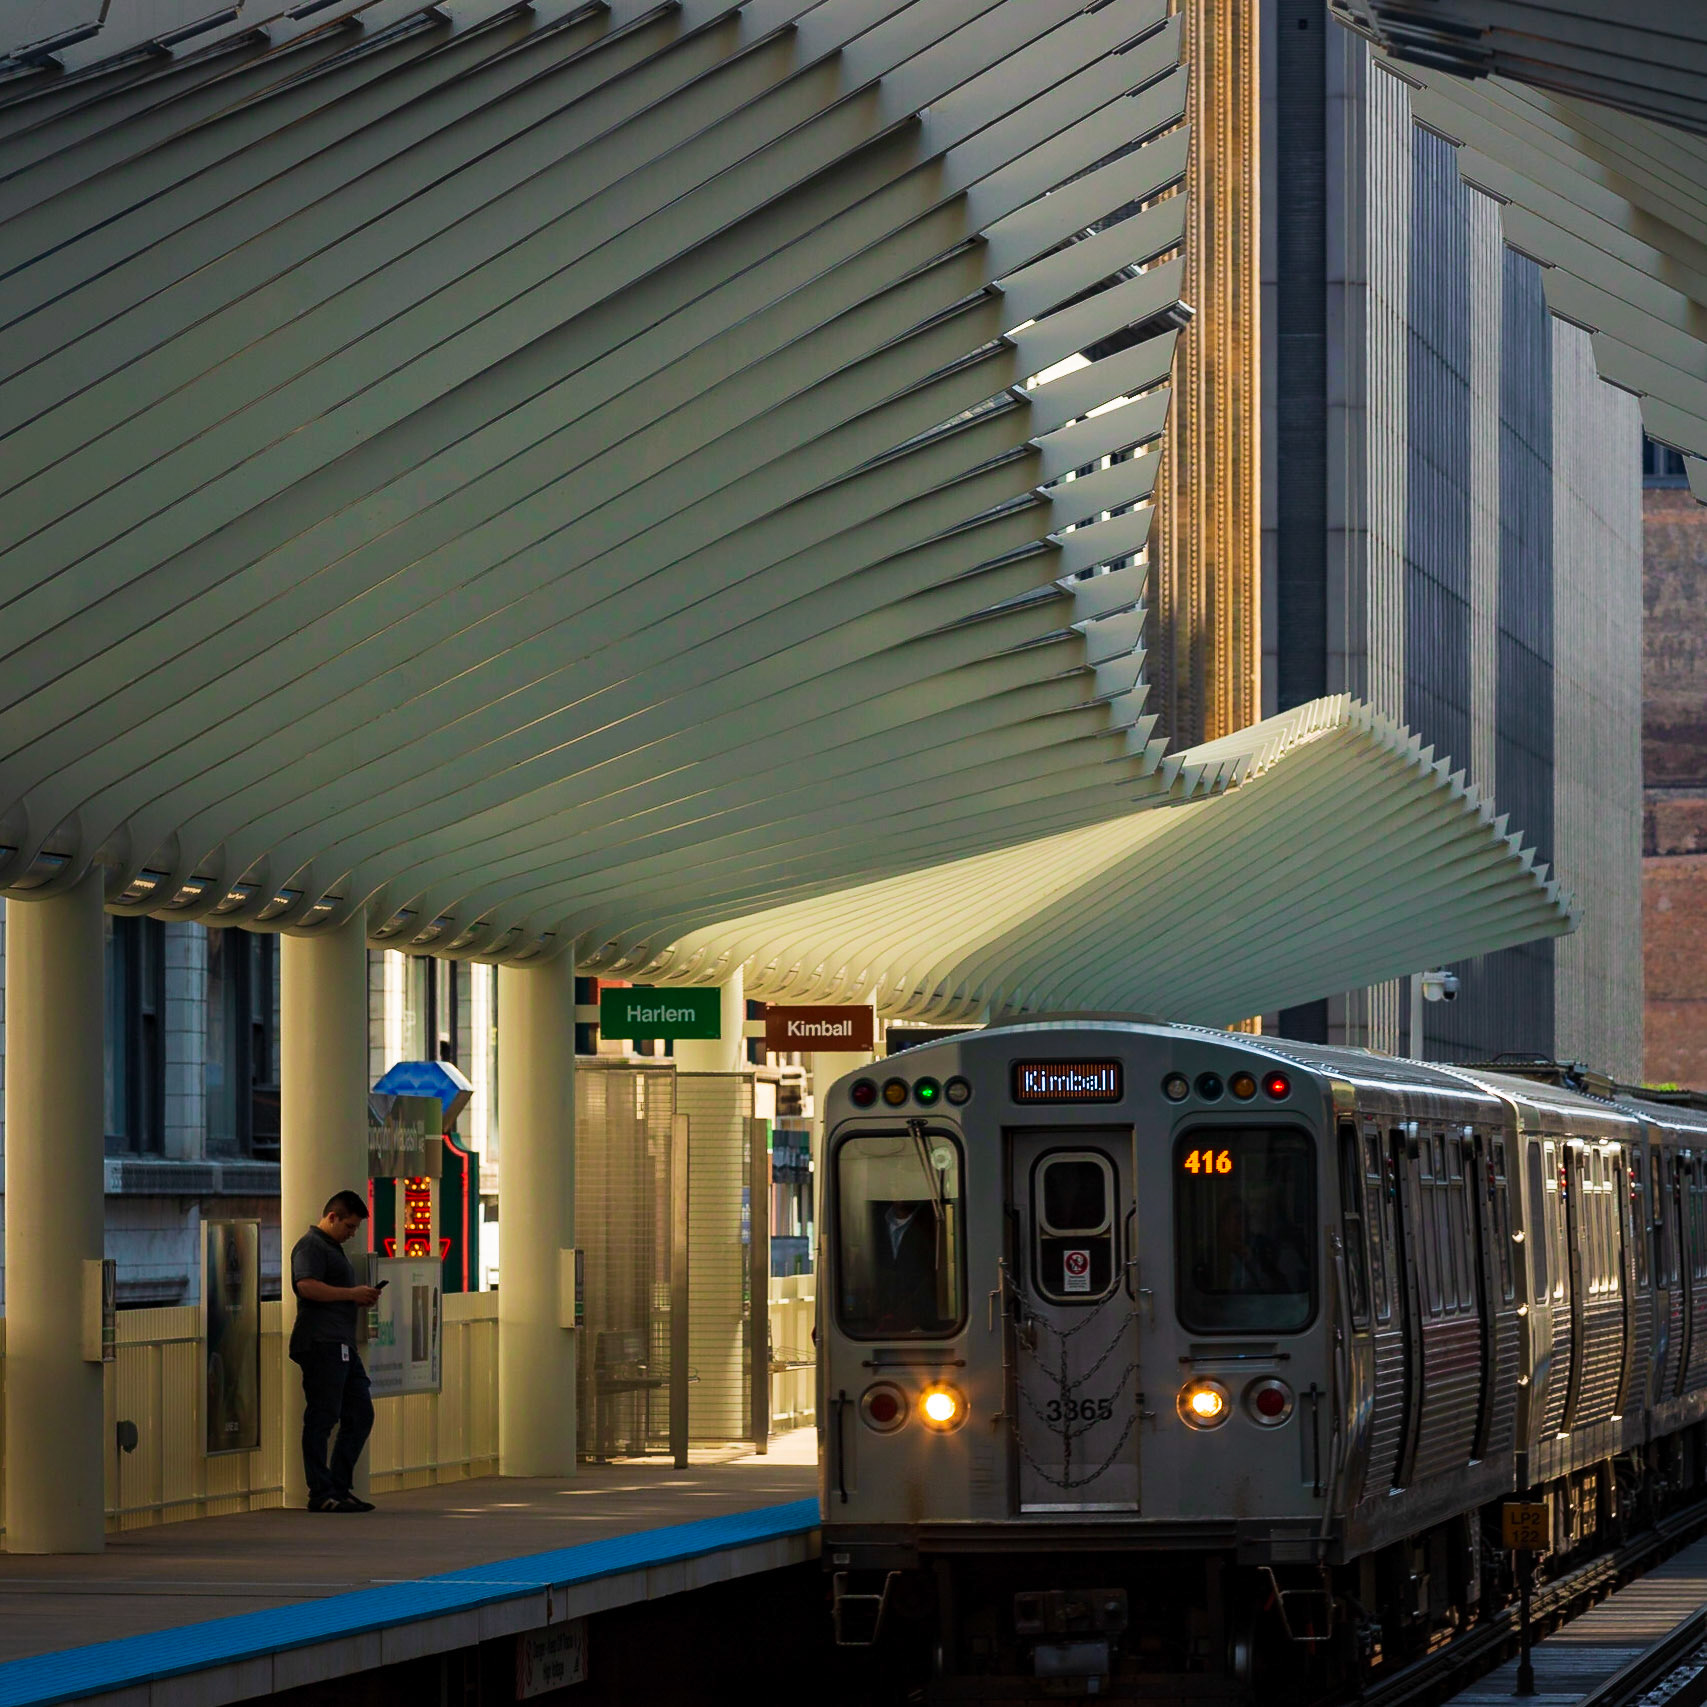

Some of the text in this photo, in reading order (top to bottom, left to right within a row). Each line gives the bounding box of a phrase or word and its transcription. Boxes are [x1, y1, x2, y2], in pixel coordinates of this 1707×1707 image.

[627, 1005, 695, 1022] Harlem
[788, 1020, 852, 1037] Kimball
[1025, 1069, 1114, 1092] Kimball
[1184, 1150, 1232, 1174] 416
[1046, 1399, 1113, 1422] 3365
[1511, 1511, 1541, 1526] LP2
[1512, 1530, 1539, 1543] 122
